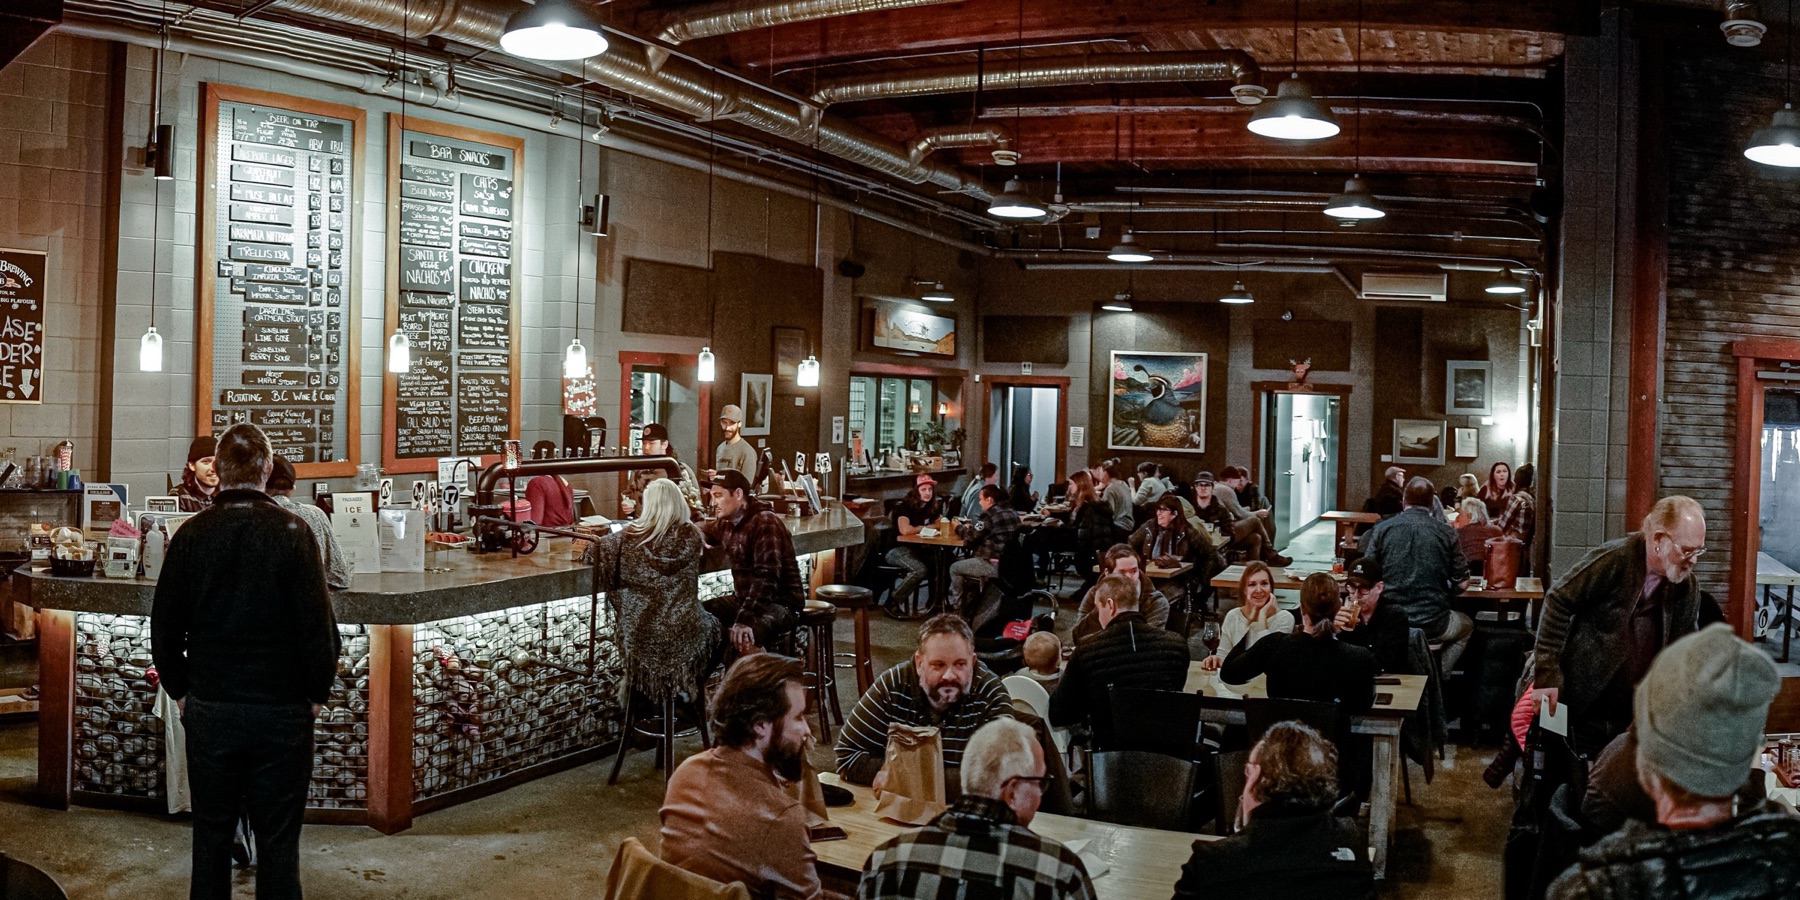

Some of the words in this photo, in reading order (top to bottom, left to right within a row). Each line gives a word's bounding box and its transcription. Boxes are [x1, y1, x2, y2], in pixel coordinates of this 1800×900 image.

[267, 113, 289, 124] BEER
[292, 118, 302, 126] ON
[304, 119, 319, 129] TAP
[308, 138, 323, 152] ABV
[330, 141, 343, 153] IBU
[430, 145, 453, 161] BAR
[459, 150, 490, 166] SNACKS
[333, 161, 342, 171] 20
[473, 175, 498, 190] CHIPS
[428, 188, 446, 199] NUTS
[473, 190, 495, 201] SALSA
[331, 199, 342, 210] 35
[231, 227, 265, 241] NARAMATA
[331, 237, 342, 247] 20
[237, 246, 272, 259] TRELLIS
[274, 249, 291, 261] IPA
[407, 248, 435, 262] SANTA
[438, 250, 449, 262] FE
[419, 261, 440, 270] VEGGIE
[469, 260, 505, 276] CHICKEN
[0, 260, 34, 288] BREWING
[252, 273, 282, 281] IMPERIAL
[330, 274, 340, 284] 60
[406, 269, 441, 285] NACHOS
[329, 293, 340, 304] 60
[406, 292, 427, 304] VEGAN
[427, 294, 449, 306] NACHOS
[469, 287, 496, 301] NACHOS
[467, 305, 485, 314] STEAM
[486, 305, 504, 315] BUNS
[254, 314, 285, 322] OATMEAL
[286, 315, 305, 323] STOUT
[259, 307, 295, 316] DARKLING
[310, 313, 323, 323] 5.5
[330, 314, 340, 325] 30
[400, 312, 417, 322] MEAT
[431, 311, 445, 320] MEAT
[0, 315, 36, 342] ASE
[402, 322, 423, 331] BOARD
[254, 334, 273, 342] LIME
[274, 334, 290, 342] GOSE
[330, 334, 338, 343] 15
[432, 341, 447, 351] $29
[250, 353, 271, 362] BERRY
[274, 354, 291, 362] SOUR
[331, 352, 339, 362] 15
[408, 357, 424, 366] arrot
[425, 356, 444, 369] Ginger
[412, 366, 428, 376] Soup
[438, 366, 449, 374] $12
[0, 366, 16, 388] E
[329, 375, 339, 385] 30
[227, 390, 263, 402] ROTATING
[292, 392, 311, 401] WINE
[311, 390, 317, 403] &
[319, 391, 336, 402] CIDER
[406, 416, 420, 428] FALL
[421, 415, 441, 427] SALAD
[460, 424, 492, 434] CARAMELIZED
[492, 424, 509, 433] ONION
[461, 433, 485, 441] SAUSAGE
[445, 489, 457, 505] 17
[1759, 610, 1766, 627] 6
